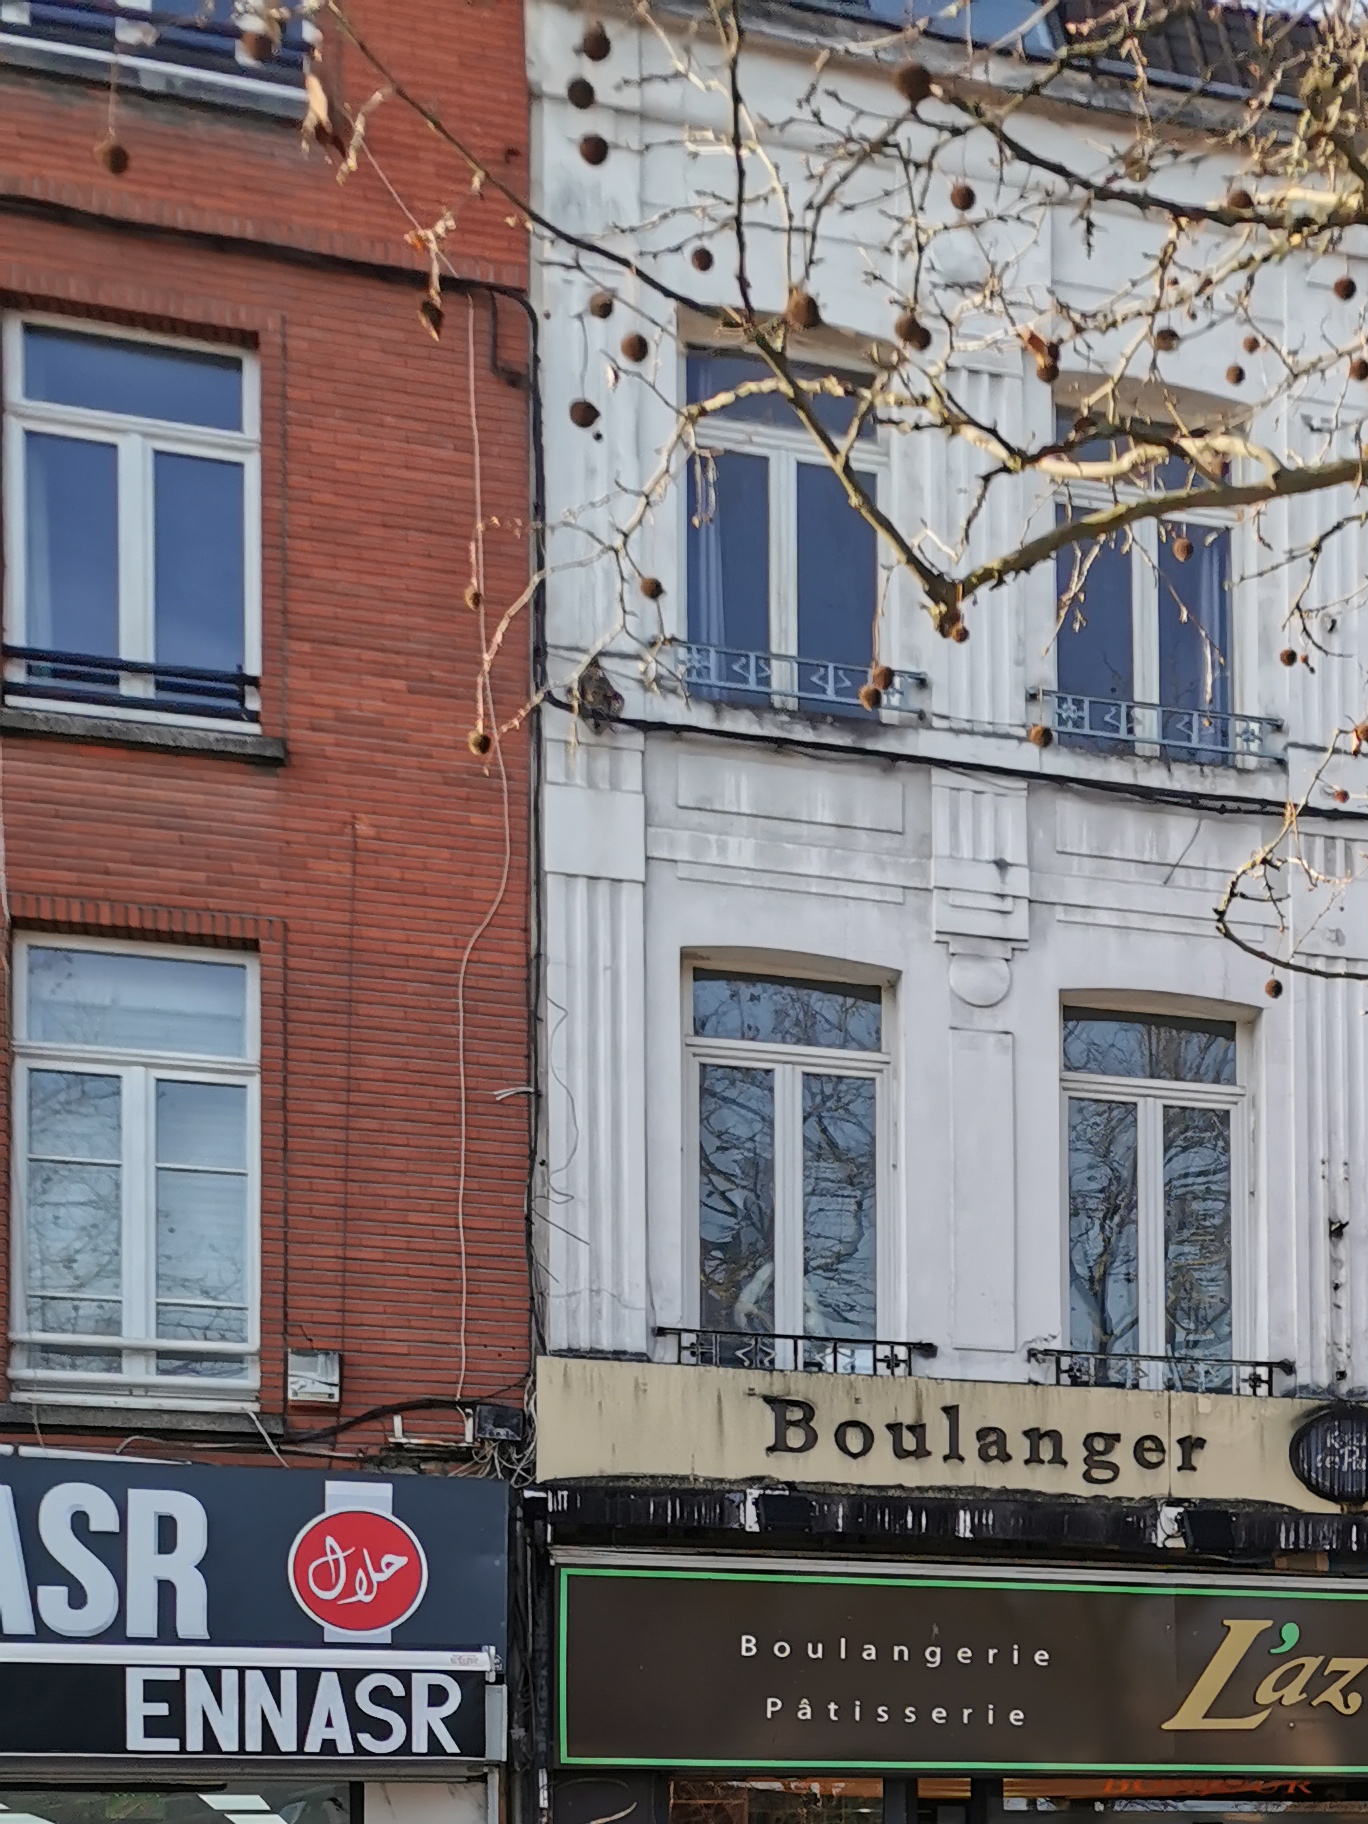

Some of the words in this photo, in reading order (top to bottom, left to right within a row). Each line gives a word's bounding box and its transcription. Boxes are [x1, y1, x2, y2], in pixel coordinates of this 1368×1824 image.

[762, 1396, 1207, 1484] Boulanger
[740, 1634, 1050, 1668] Boulangerie
[126, 1666, 462, 1755] ENNASR
[766, 1696, 1026, 1728] Pâtisserie
